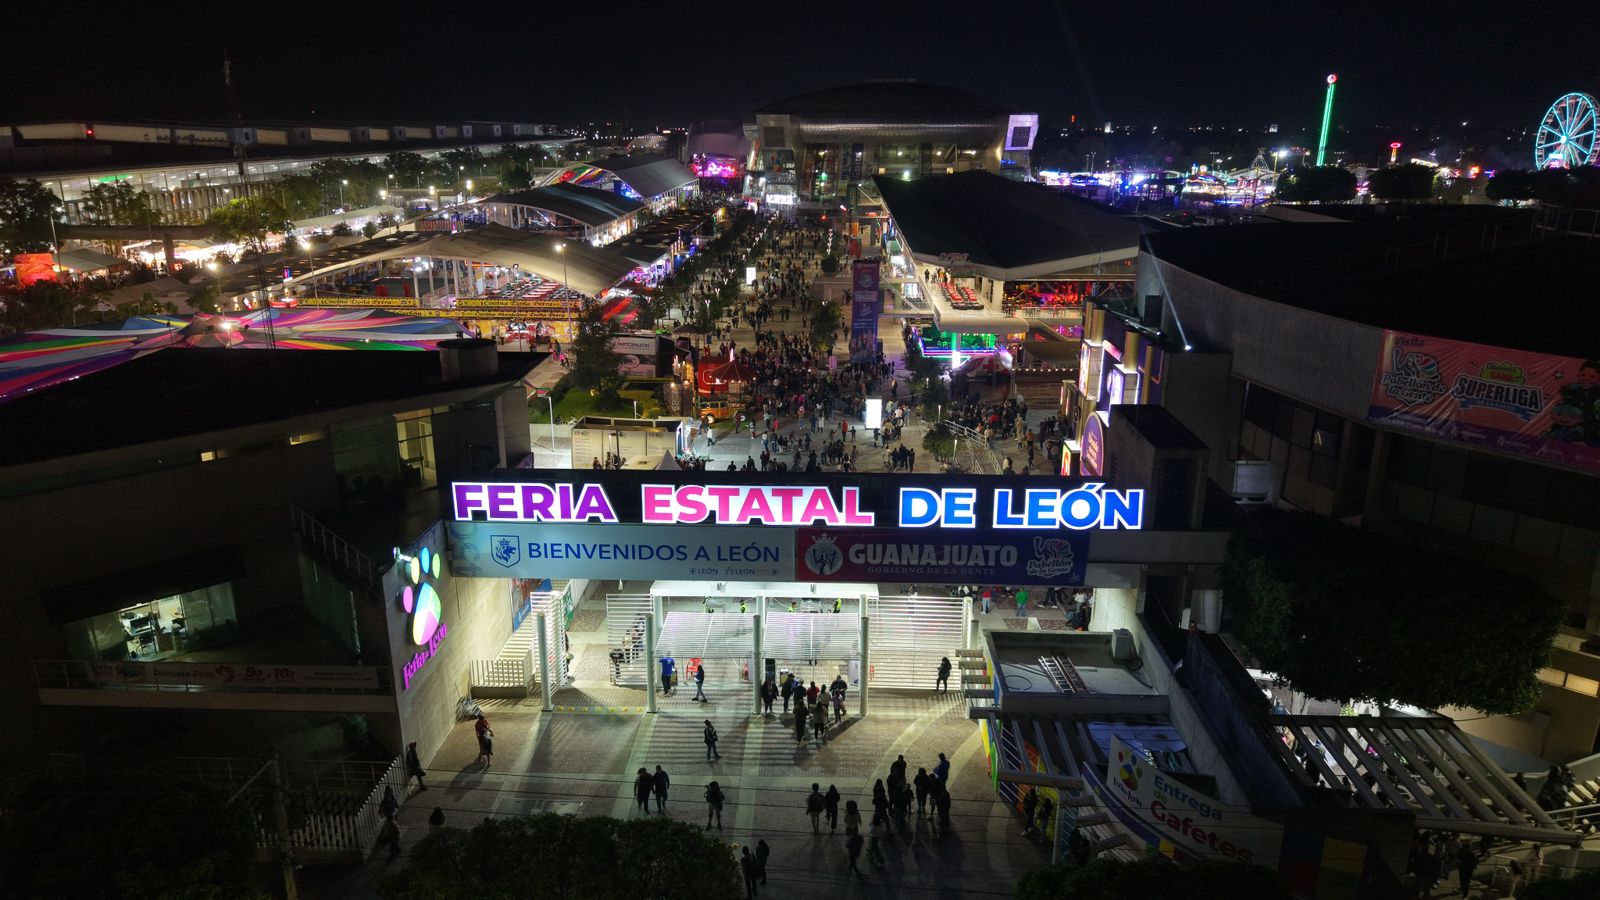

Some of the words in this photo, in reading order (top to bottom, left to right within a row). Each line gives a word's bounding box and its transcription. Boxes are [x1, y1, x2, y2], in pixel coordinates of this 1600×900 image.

[1456, 376, 1541, 411] SUPERLIGA
[451, 482, 620, 523] FERIA
[641, 484, 875, 527] ESTATAL
[898, 487, 976, 528] DE
[992, 482, 1144, 530] LEÓN
[527, 542, 689, 562] BIENVENIDOS
[694, 545, 711, 561] A
[716, 541, 780, 563] LEÓN
[848, 543, 1018, 567] GUANAJUATO
[868, 566, 924, 574] GOBIERNO
[944, 567, 957, 576] LA
[960, 567, 997, 576] GENTE
[1152, 789, 1169, 803] de
[1153, 774, 1223, 822] Entrega
[1150, 799, 1254, 863] Gafetes
